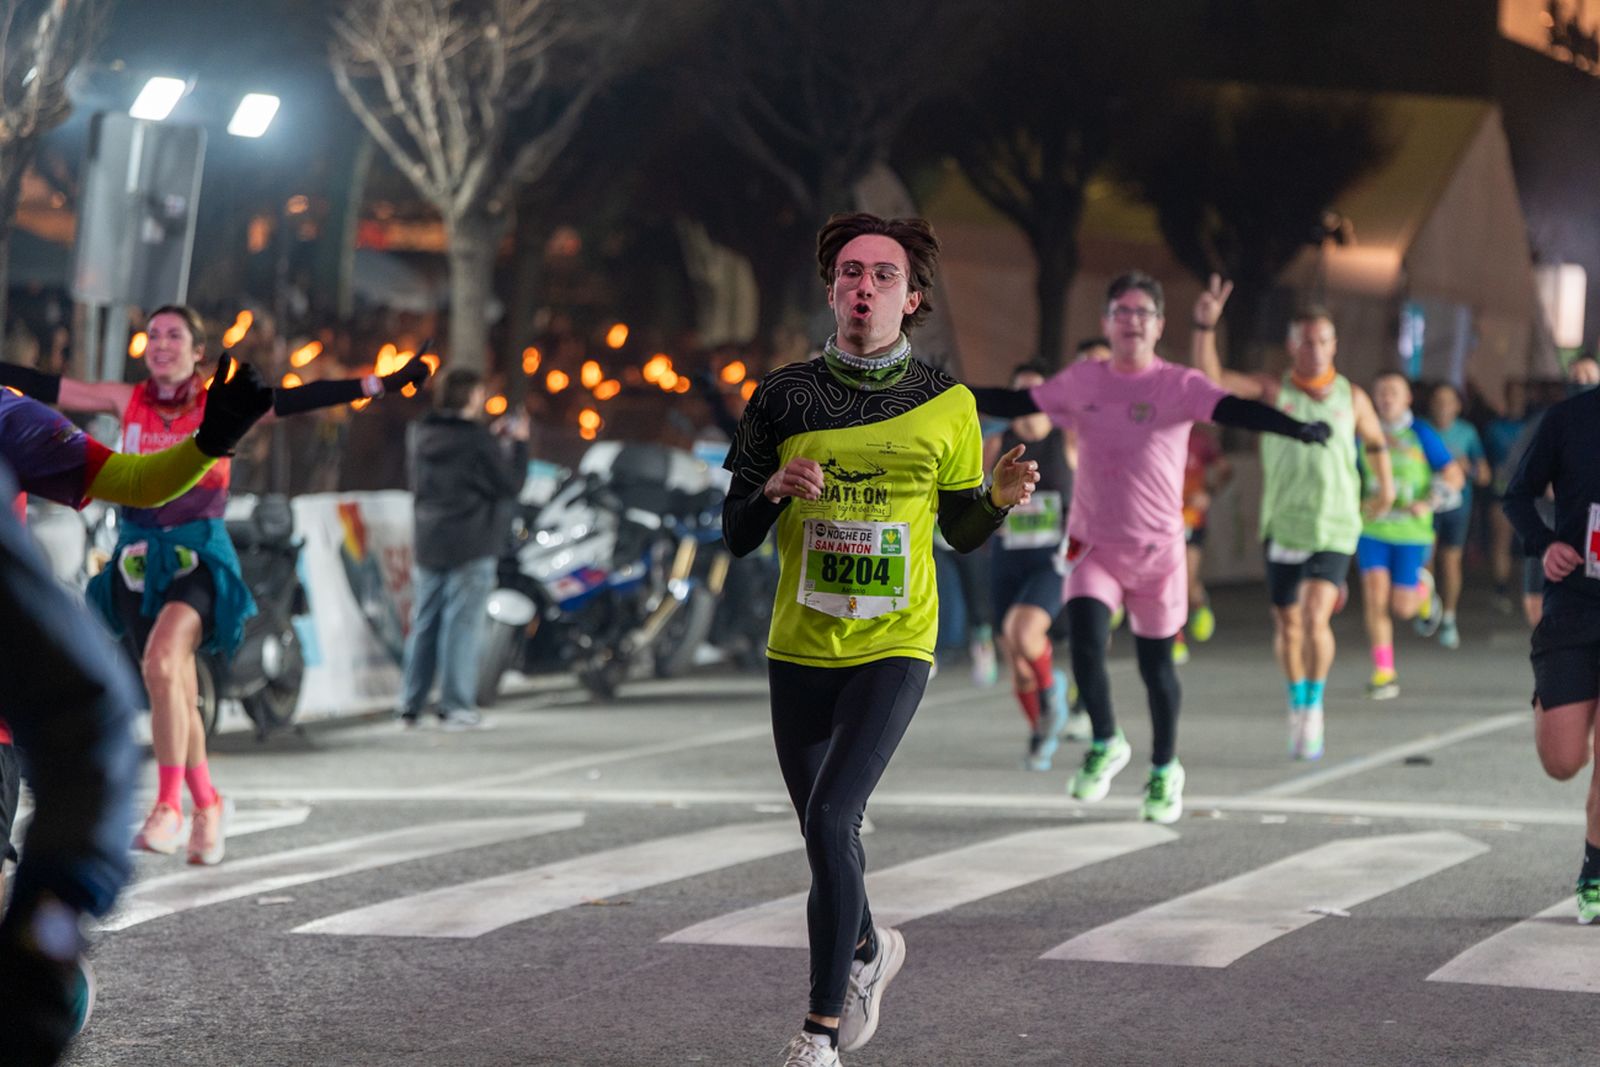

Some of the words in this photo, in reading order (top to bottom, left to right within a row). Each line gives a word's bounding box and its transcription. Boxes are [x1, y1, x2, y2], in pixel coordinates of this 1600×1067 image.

[819, 484, 888, 505] IATLON
[827, 529, 858, 541] NOCHE
[860, 532, 872, 542] DE
[815, 539, 834, 551] SAN
[821, 553, 890, 586] 8204
